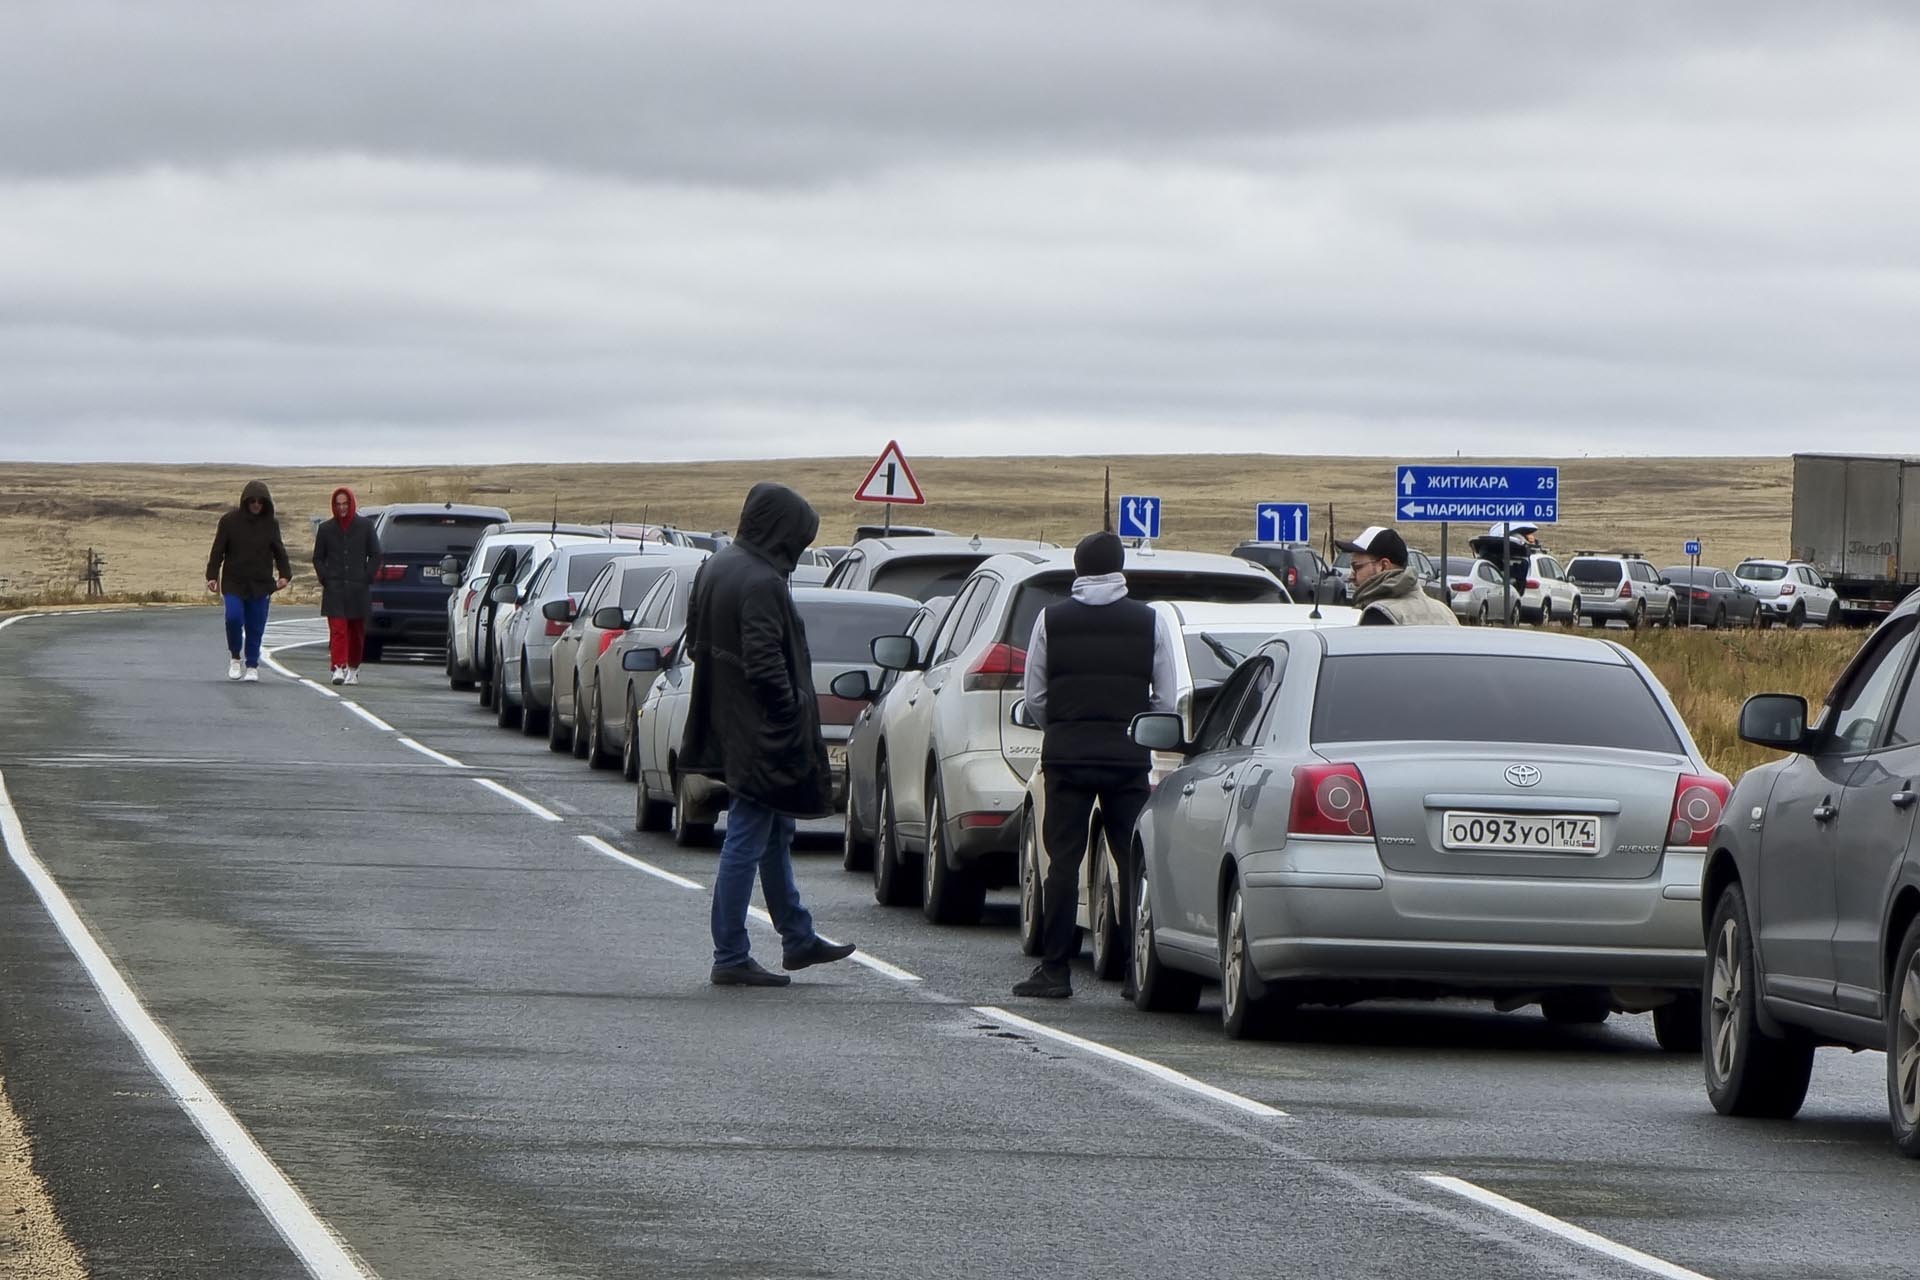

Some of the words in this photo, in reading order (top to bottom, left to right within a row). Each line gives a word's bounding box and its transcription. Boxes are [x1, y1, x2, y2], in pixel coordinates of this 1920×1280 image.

[1427, 475, 1509, 489] ЖИТИКАРА
[1536, 477, 1554, 490] 25
[1426, 502, 1525, 517] МАРИИНСКИЙ
[1534, 505, 1554, 517] 0.5
[1555, 821, 1591, 840] 174
[1380, 836, 1416, 845] TOYOTA
[1563, 839, 1581, 847] RUS
[1616, 844, 1660, 853] AVENSIS
